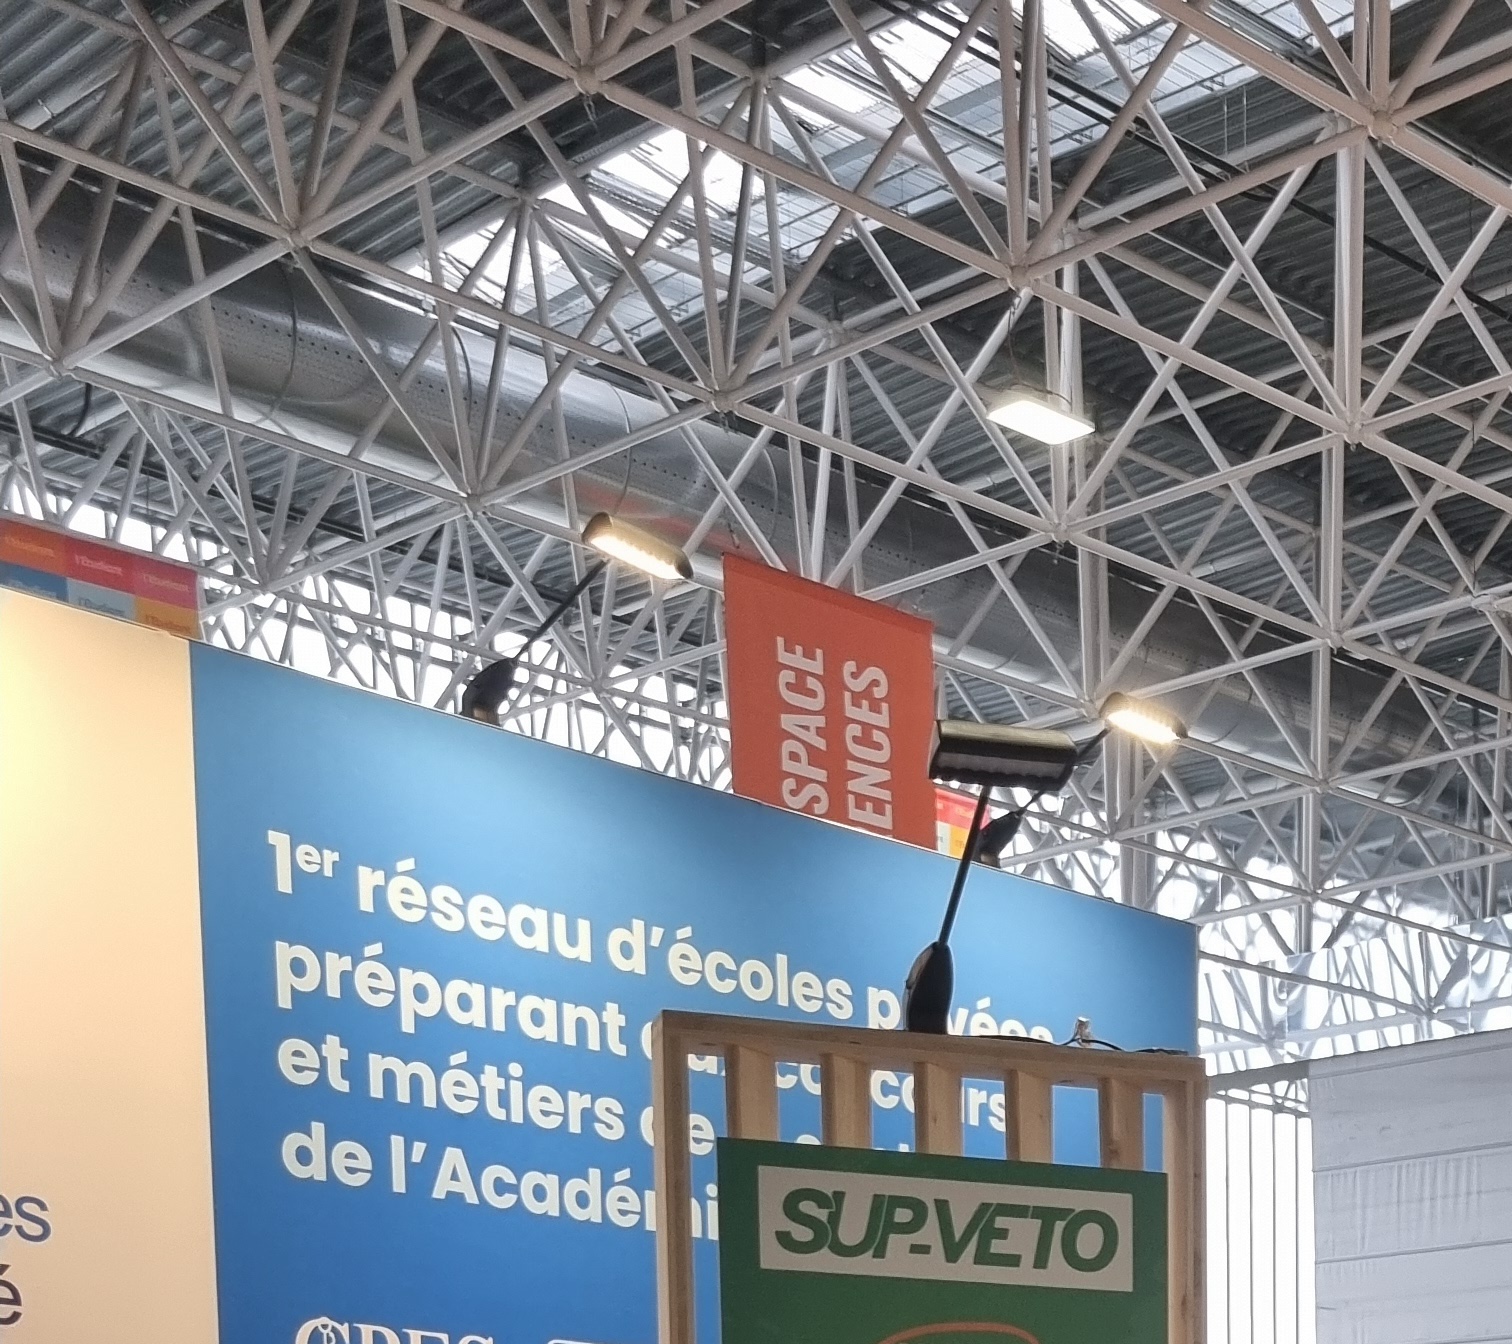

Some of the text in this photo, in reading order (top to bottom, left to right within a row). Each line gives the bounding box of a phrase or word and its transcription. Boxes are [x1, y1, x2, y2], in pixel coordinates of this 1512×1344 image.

[776, 635, 830, 815] SPACE
[843, 660, 894, 830] ENCES
[267, 829, 340, 894] 1er
[357, 857, 592, 963] réseau
[607, 918, 853, 1019] d'écoles
[275, 941, 627, 1056] préparant
[277, 1034, 350, 1092] et
[368, 1051, 625, 1141] métiers
[282, 1121, 373, 1187] de
